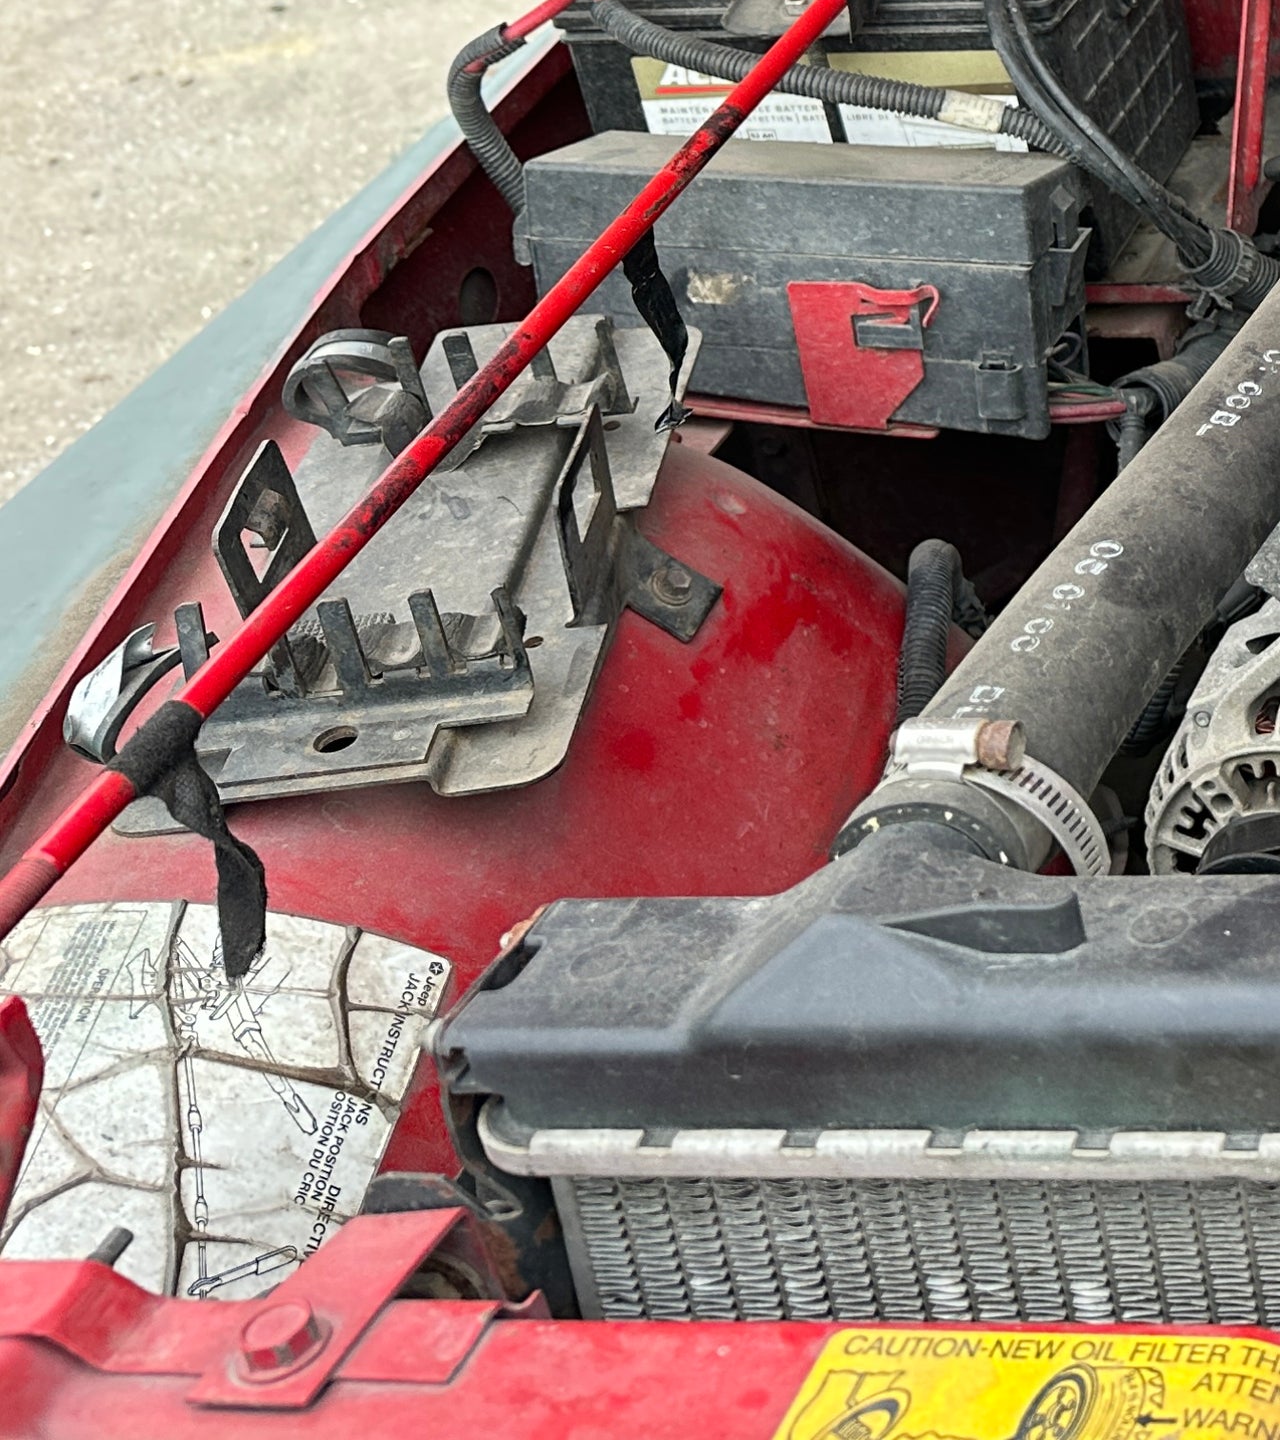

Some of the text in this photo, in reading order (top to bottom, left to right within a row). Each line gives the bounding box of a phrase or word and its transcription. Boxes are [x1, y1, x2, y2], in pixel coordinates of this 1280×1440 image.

[398, 972, 421, 1011] JACK
[417, 976, 437, 1007] Jeep
[294, 1091, 347, 1206] OSITION DU CRIC
[311, 1097, 358, 1202] JACK POSITION
[1070, 1340, 1119, 1362] OIL
[1128, 1342, 1231, 1364] FILTER
